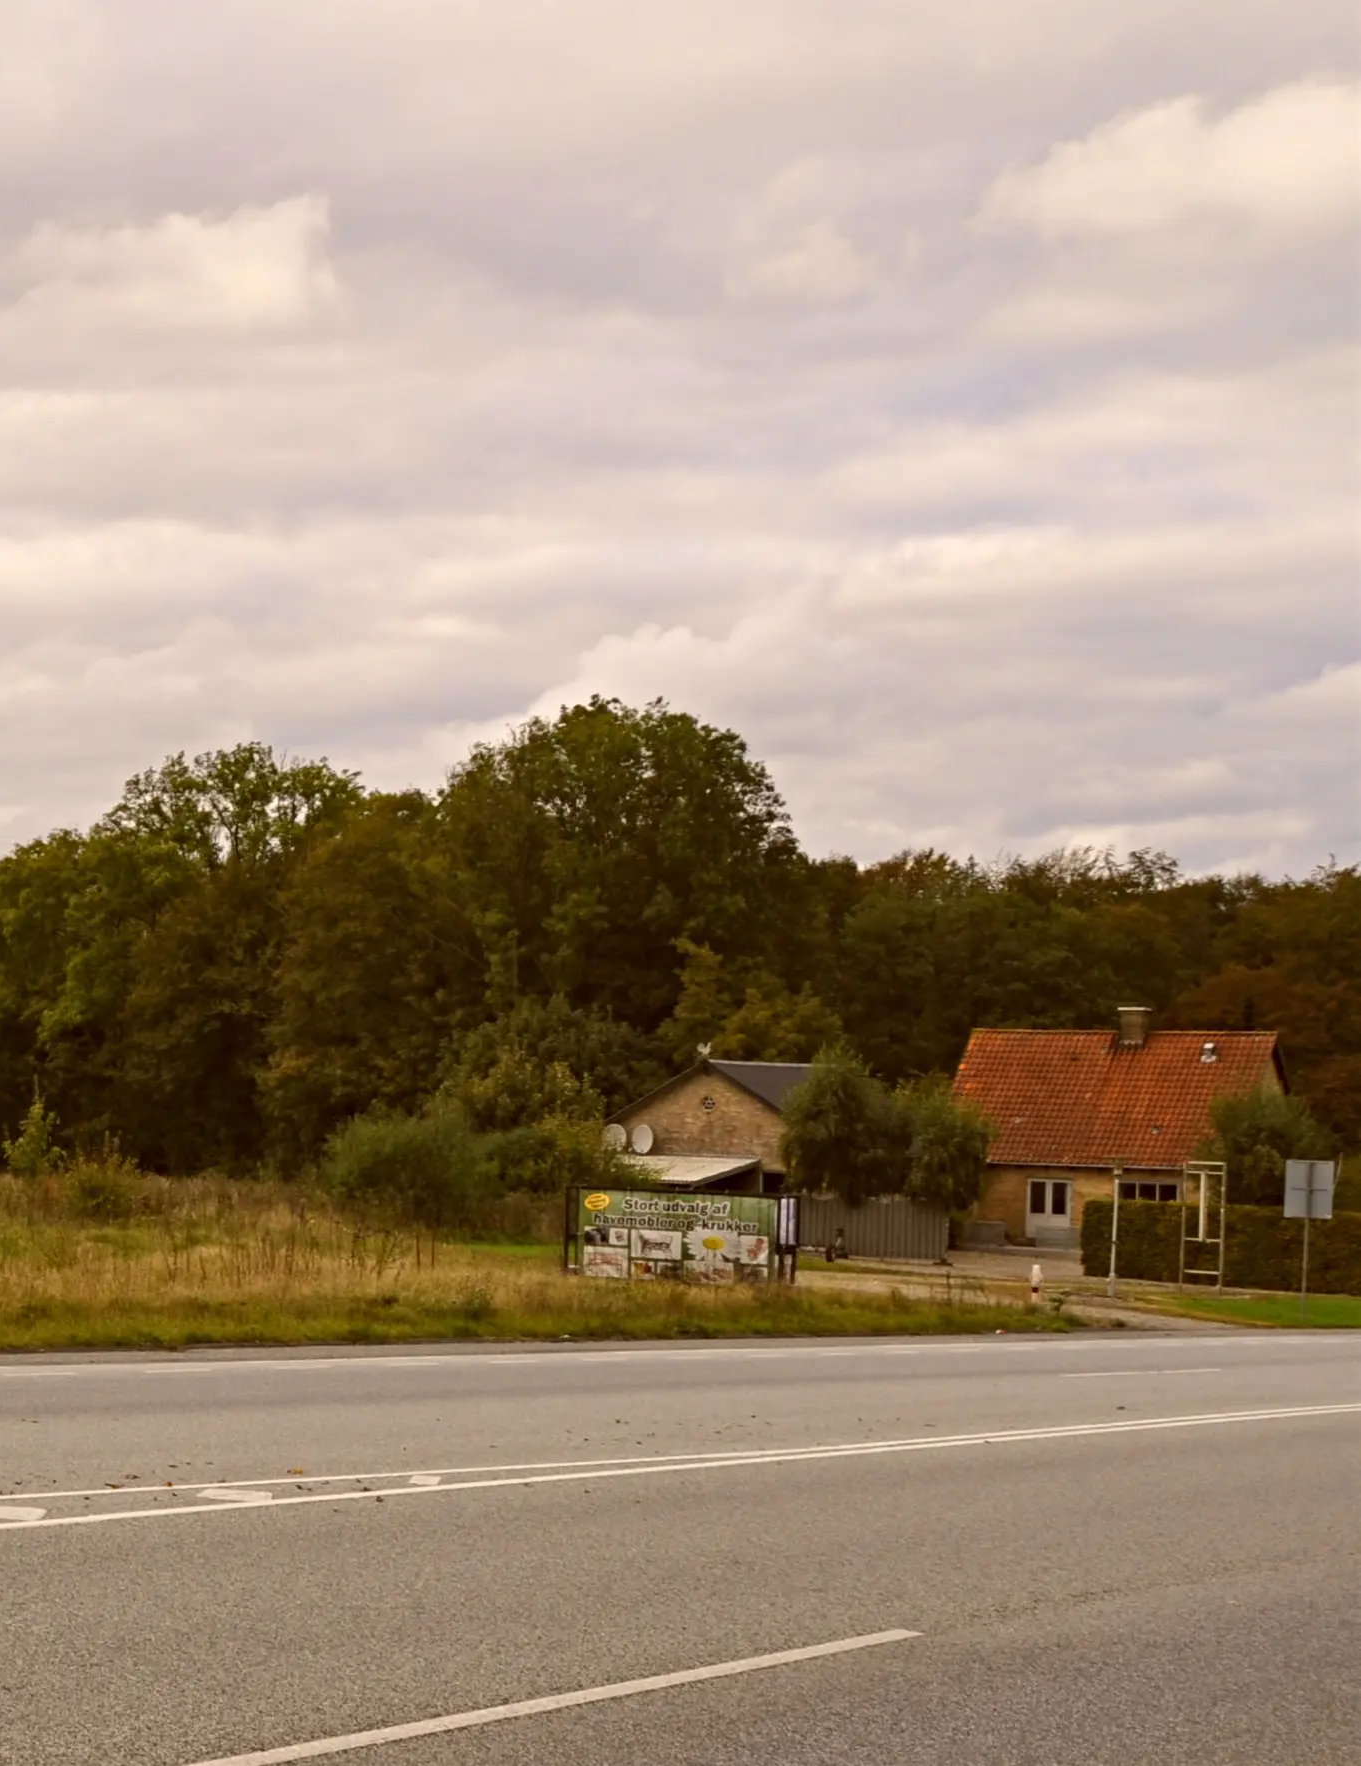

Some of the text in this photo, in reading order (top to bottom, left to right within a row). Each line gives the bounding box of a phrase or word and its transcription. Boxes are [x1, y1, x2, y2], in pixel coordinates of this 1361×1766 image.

[623, 1198, 659, 1212] Stort
[662, 1201, 711, 1215] udvalg
[713, 1203, 728, 1214] af
[678, 1220, 695, 1231] og
